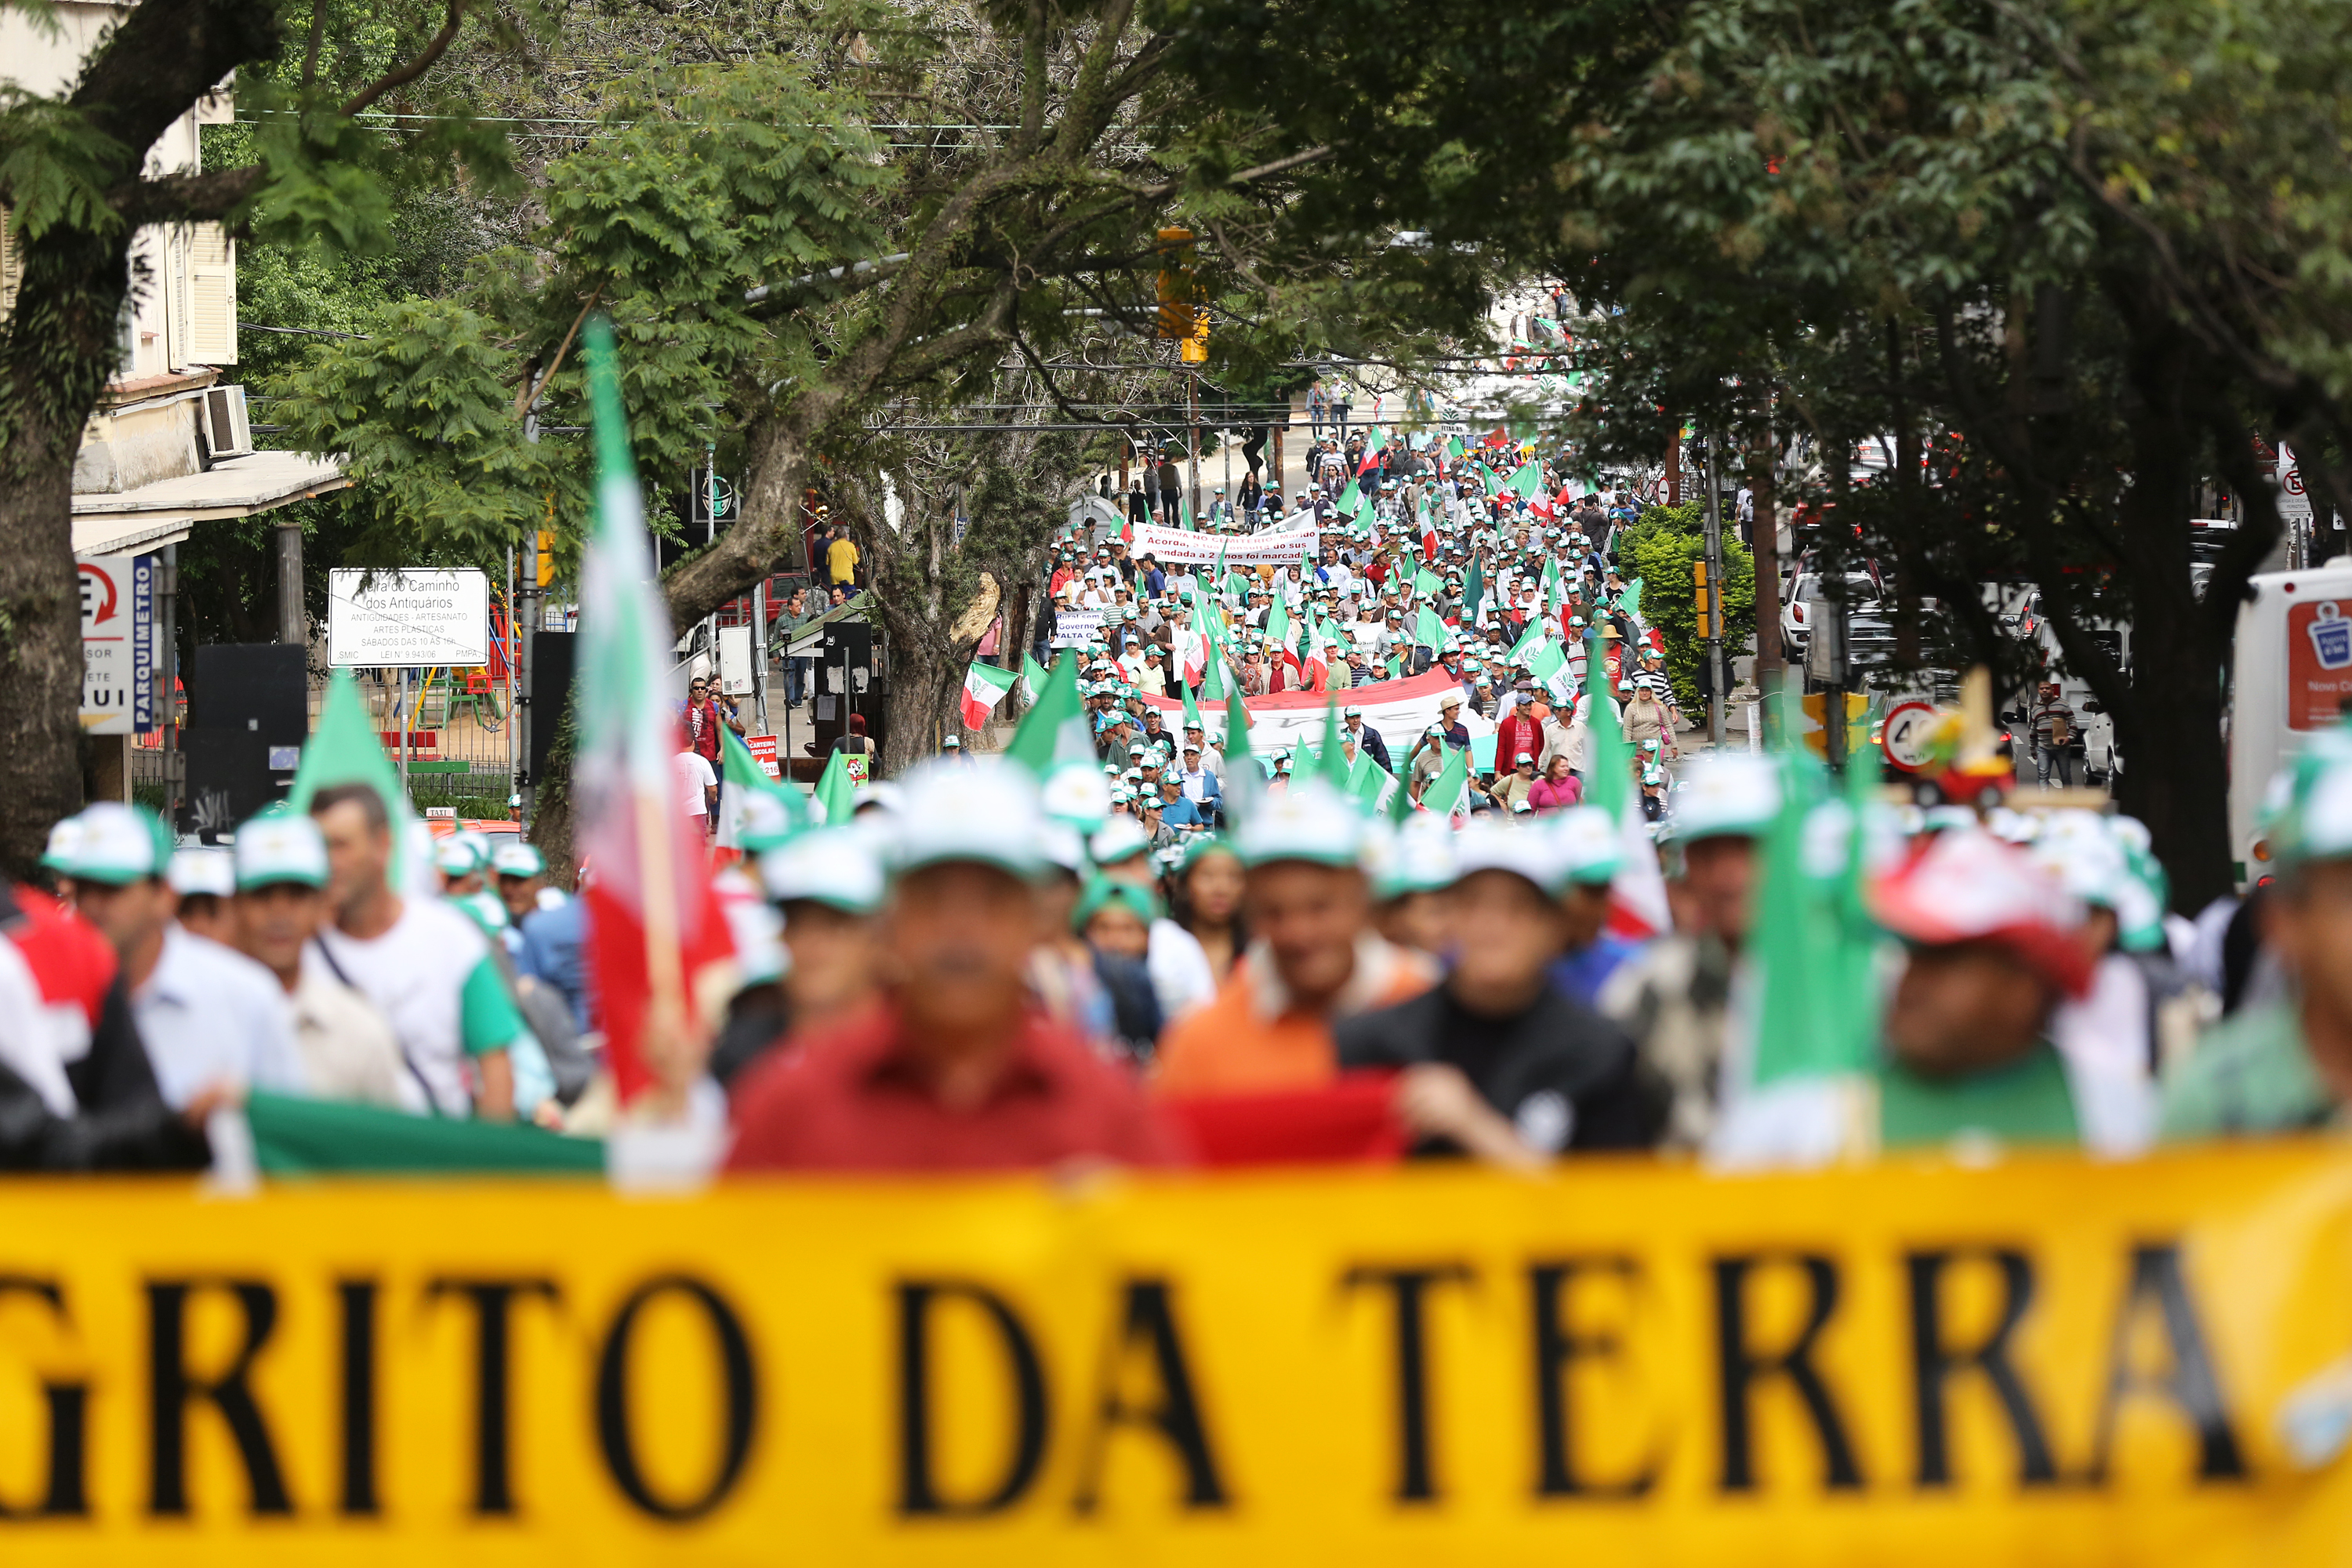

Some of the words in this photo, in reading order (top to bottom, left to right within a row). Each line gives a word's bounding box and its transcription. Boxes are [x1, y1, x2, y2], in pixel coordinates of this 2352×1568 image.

[1280, 530, 1316, 540] Marido
[1147, 536, 1189, 548] Acorda,
[365, 580, 387, 593] eira
[391, 580, 405, 592] do
[408, 579, 459, 593] Caminho
[365, 597, 387, 609] dos
[389, 597, 453, 612] Antiquários
[416, 612, 468, 621] ARTESANATO
[401, 624, 445, 633] PLÁSTICAS
[133, 565, 151, 724] PARQUÍMETRO
[361, 637, 399, 647] SÁBADOS
[401, 637, 417, 646] DAS
[85, 649, 112, 659] SOR
[339, 651, 359, 659] SMIC
[405, 650, 436, 659] 9.943/06
[456, 649, 477, 658] PMPA
[87, 673, 111, 682] ETE
[82, 689, 124, 708] UI
[750, 740, 775, 749] CARTEIRA
[751, 747, 775, 756] ESCOLAR
[0, 1276, 760, 1519] GRITO
[895, 1275, 1229, 1518] DA
[1342, 1240, 2250, 1502] TERRA
